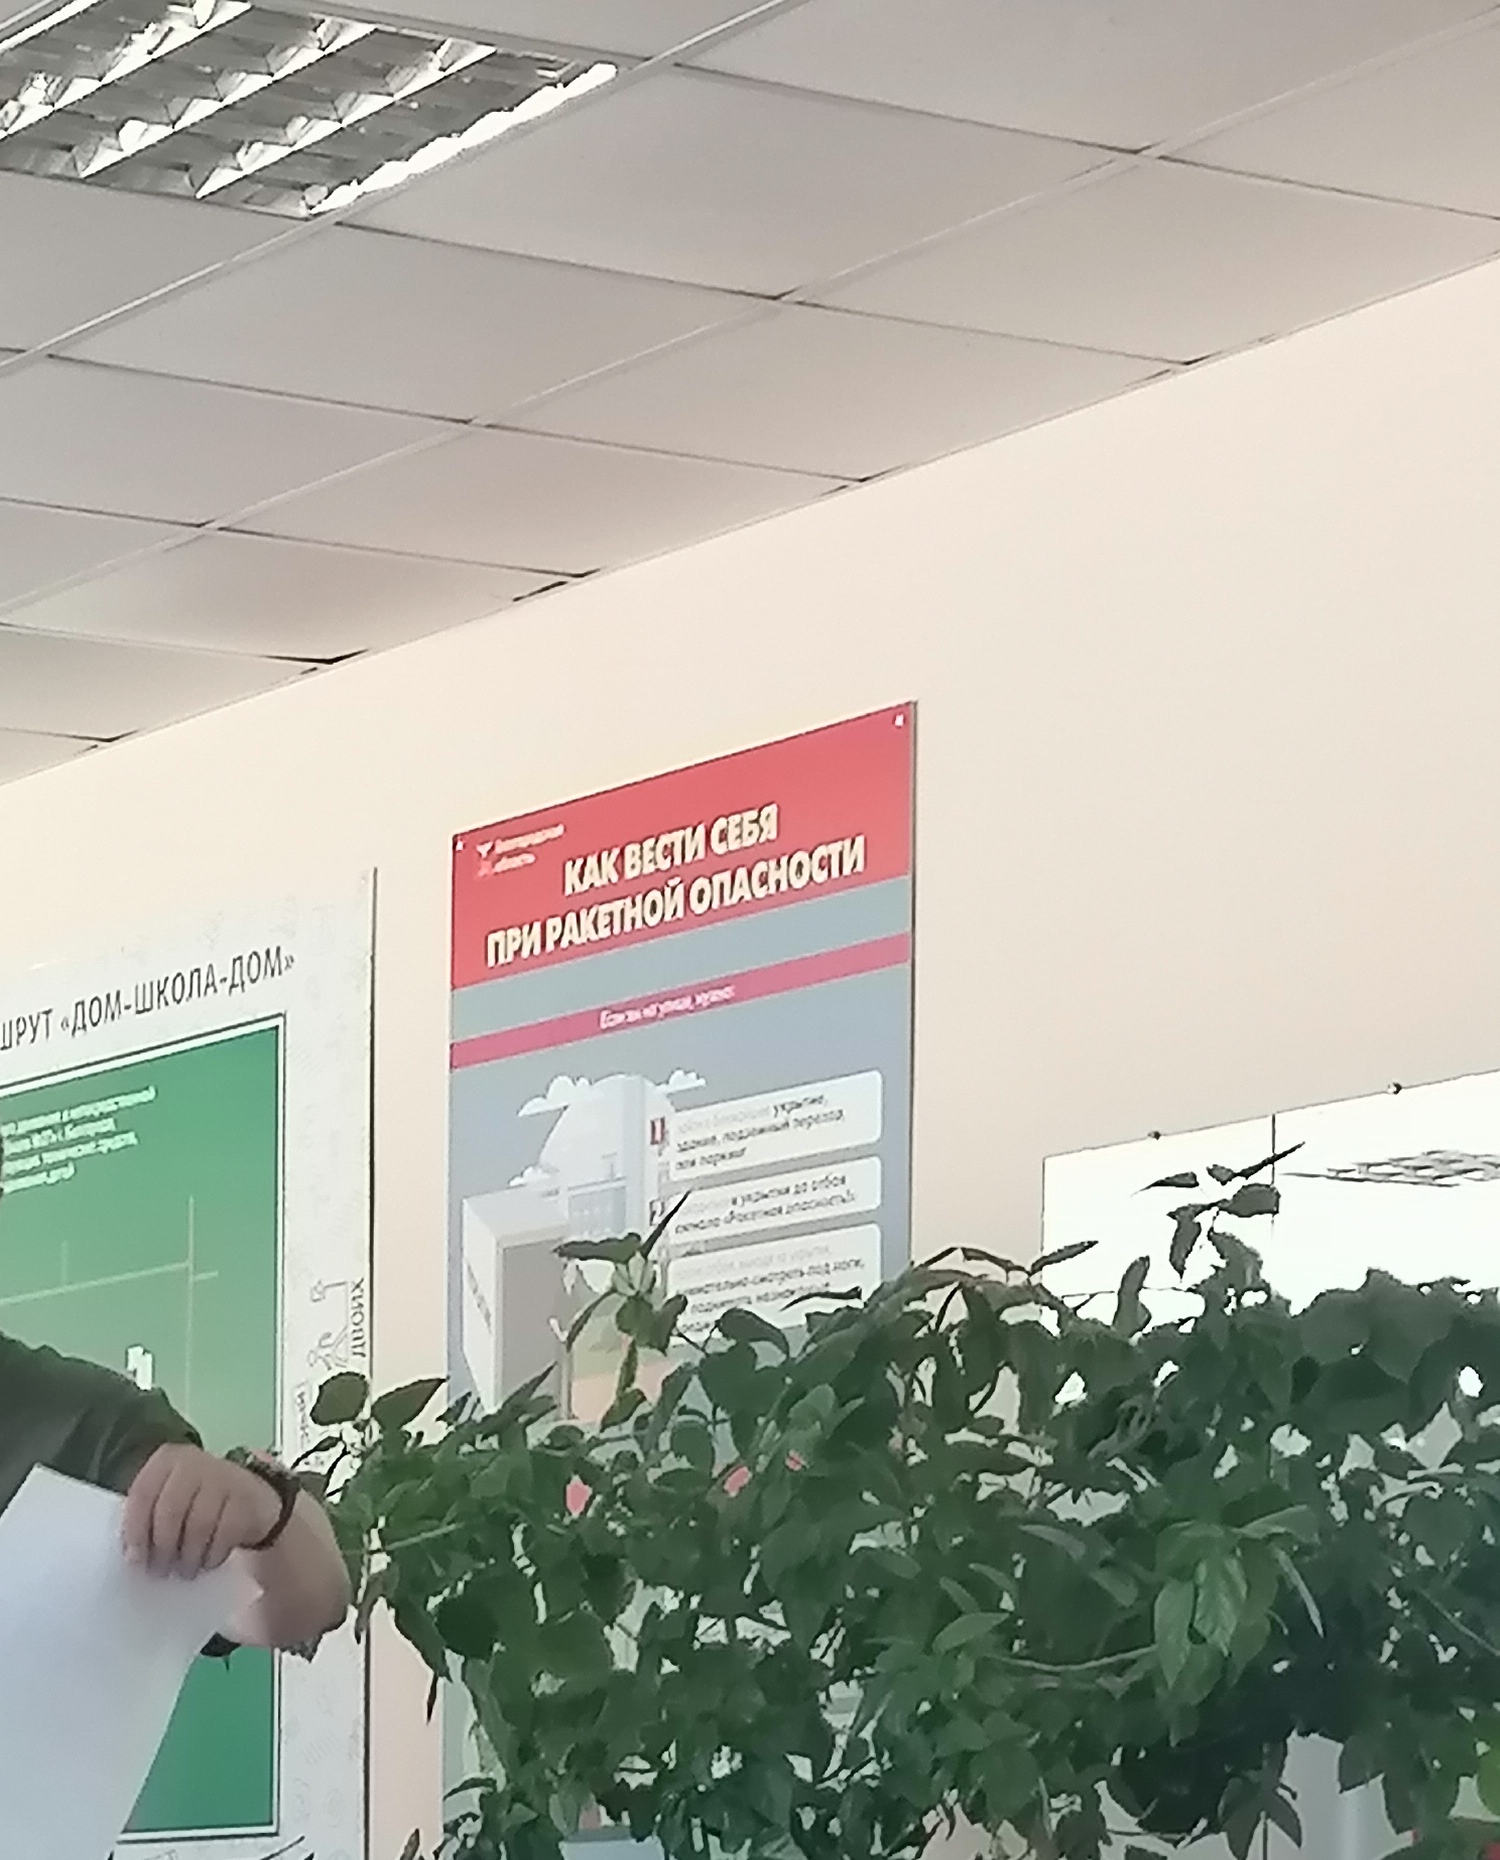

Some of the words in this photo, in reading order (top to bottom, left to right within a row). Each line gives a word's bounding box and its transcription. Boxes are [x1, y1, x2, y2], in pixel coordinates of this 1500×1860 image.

[563, 846, 621, 896] КАК
[622, 822, 707, 880] ВЕСТИ
[710, 803, 778, 855] СЕБЯ
[486, 920, 541, 968] ПРИ
[545, 877, 685, 953] РАКЕТНОЙ
[689, 834, 866, 915] ОПАСНОСТИ
[61, 945, 295, 1038] «ДОМ-ШКОЛА-ДОМ»
